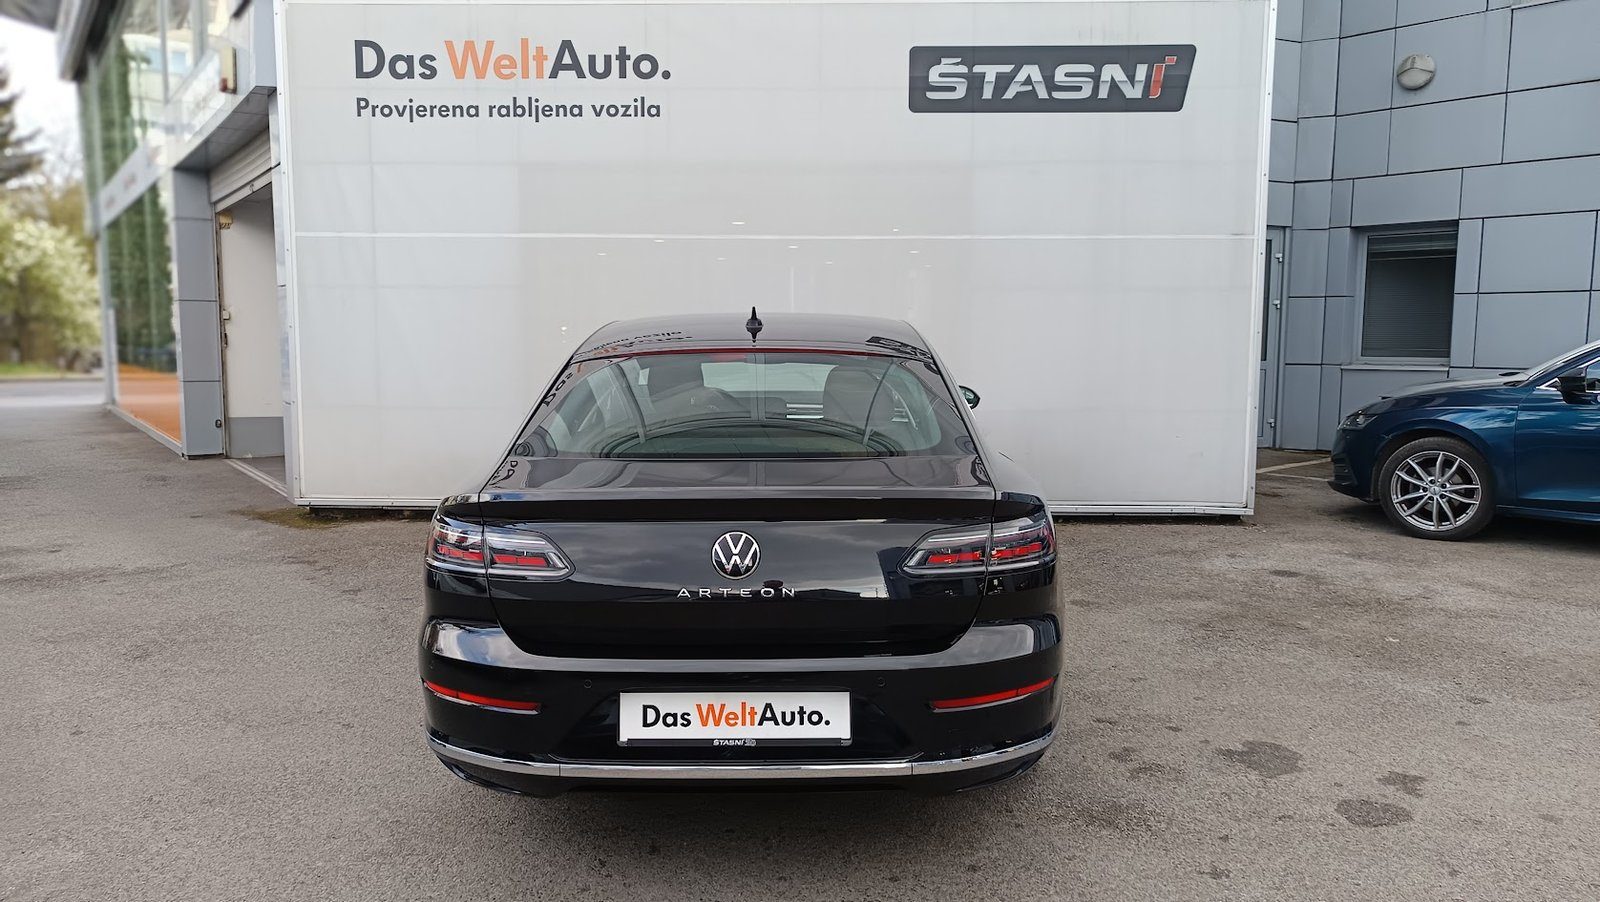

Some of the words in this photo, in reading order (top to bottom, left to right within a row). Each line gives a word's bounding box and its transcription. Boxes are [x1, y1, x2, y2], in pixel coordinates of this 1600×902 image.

[354, 39, 437, 80] Das
[444, 38, 671, 80] WeltAuto.
[356, 97, 479, 123] Provjerena
[488, 97, 583, 123] rabljena
[591, 96, 661, 118] vozila
[677, 587, 795, 598] ARTEON
[642, 704, 691, 728] Das
[696, 702, 830, 728] WeltAuto.
